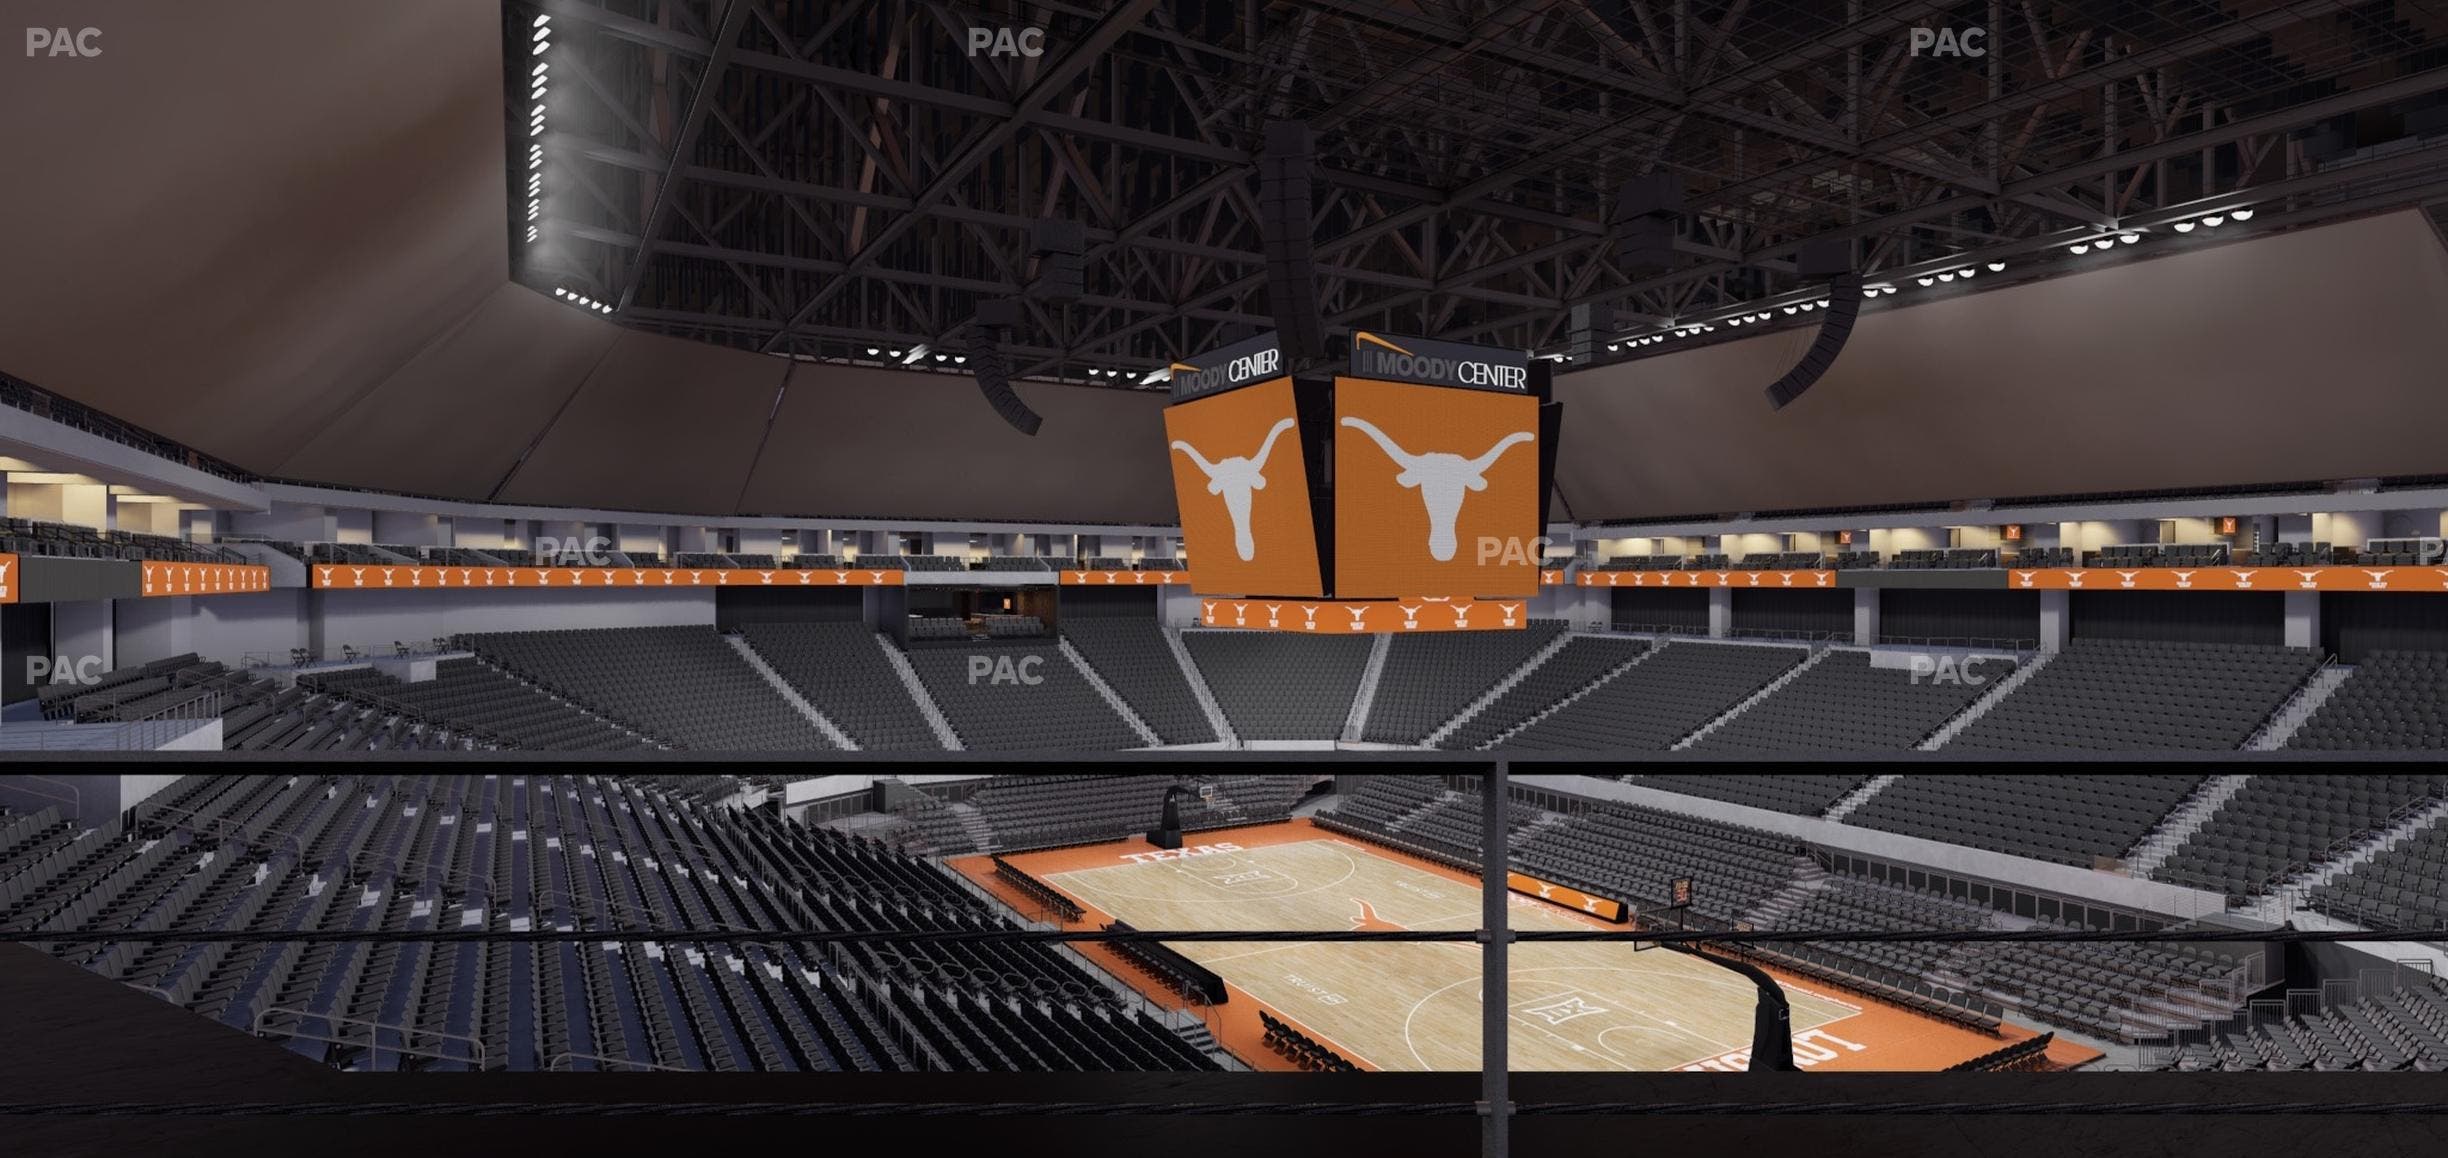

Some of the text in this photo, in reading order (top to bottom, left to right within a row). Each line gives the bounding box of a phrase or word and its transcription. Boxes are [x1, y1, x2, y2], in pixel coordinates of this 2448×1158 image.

[1180, 348, 1279, 396] MOODY CENTER
[1377, 350, 1527, 389] MOODY CENTER
[1119, 842, 1244, 865] TEXAS
